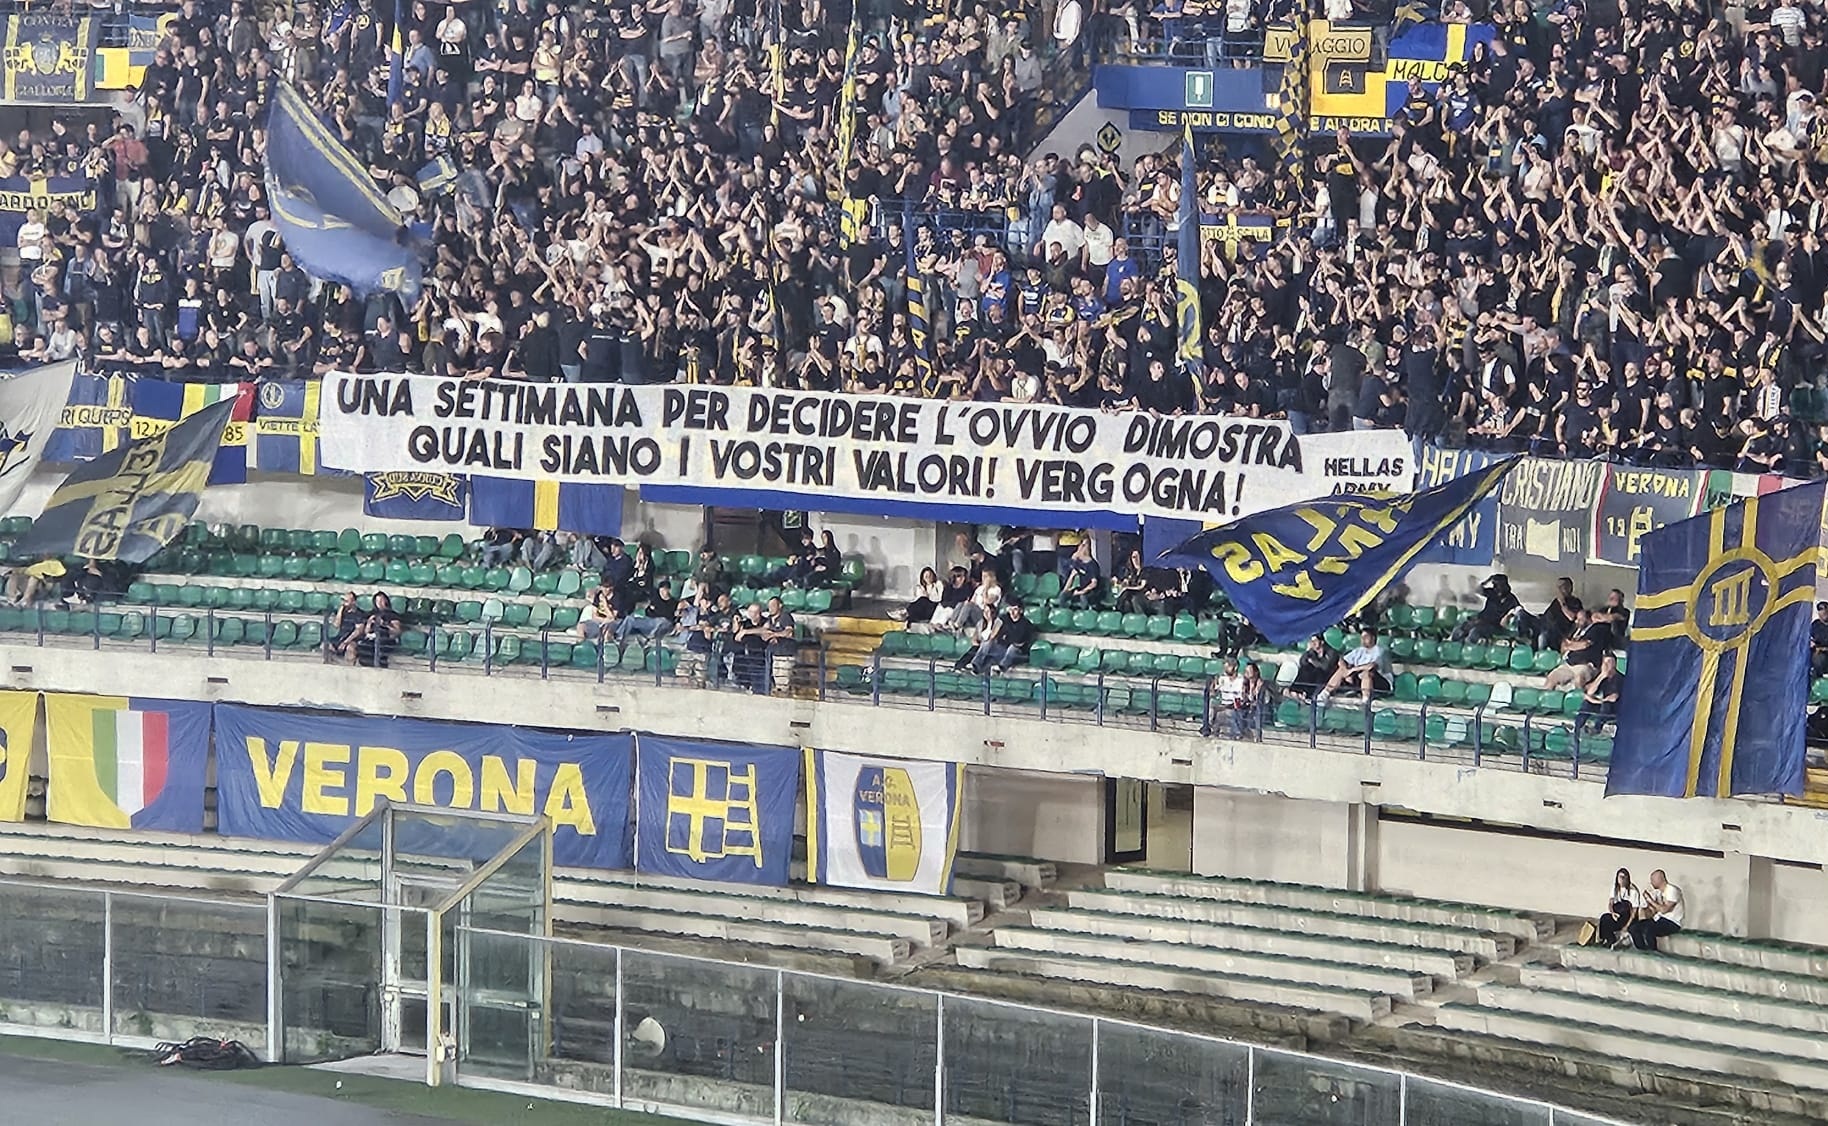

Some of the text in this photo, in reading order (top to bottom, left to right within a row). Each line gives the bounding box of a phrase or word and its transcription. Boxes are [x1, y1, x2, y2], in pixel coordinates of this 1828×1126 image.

[1274, 37, 1366, 55] VIAGGIO
[1393, 61, 1447, 81] MALC
[1158, 110, 1177, 126] SE
[1181, 111, 1213, 127] NON
[337, 377, 1304, 474] UNA SETTIMANA PER DECIDERE L'OVVIO DIMOSTRA
[408, 424, 524, 470] QUALI
[540, 434, 662, 476] SIANO
[680, 436, 689, 477] I
[709, 439, 836, 487] VOSTRI
[853, 448, 998, 499] VALORI!
[1324, 457, 1404, 477] HELLAS
[1501, 459, 1597, 511] CRISTIANO
[1614, 471, 1690, 498] VERONA
[1504, 522, 1582, 553] TRA NOI
[245, 735, 597, 836] VERONA
[859, 790, 911, 808] VERONA
